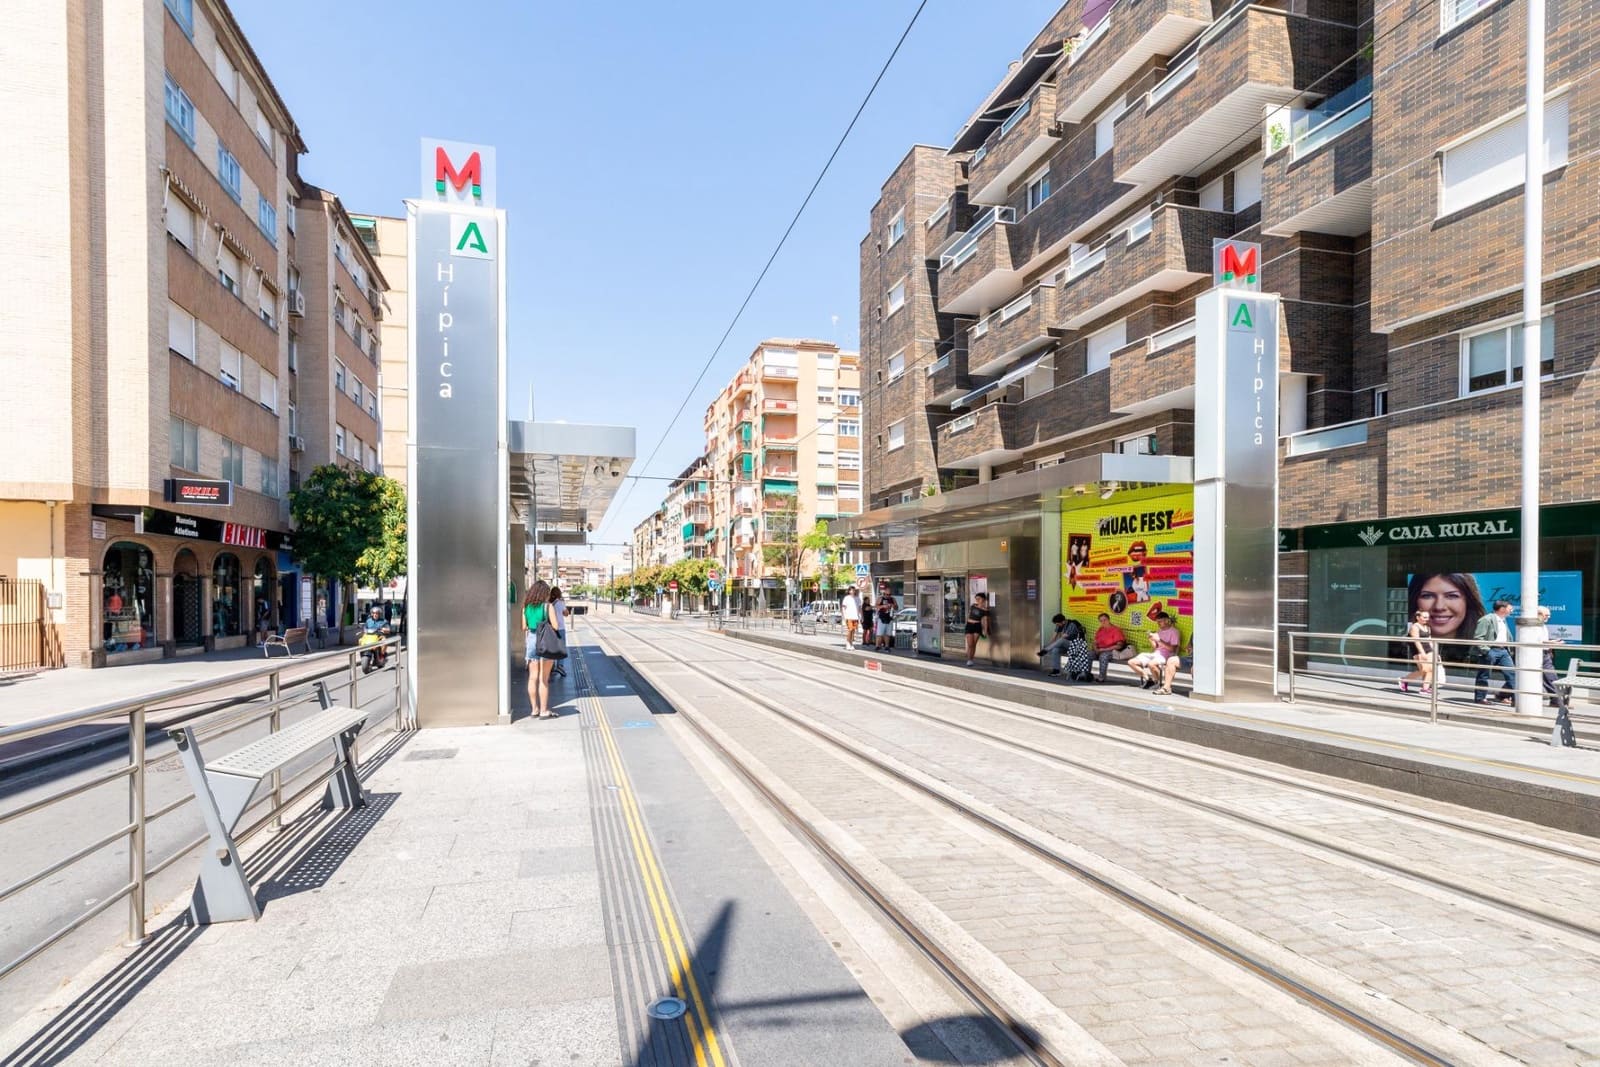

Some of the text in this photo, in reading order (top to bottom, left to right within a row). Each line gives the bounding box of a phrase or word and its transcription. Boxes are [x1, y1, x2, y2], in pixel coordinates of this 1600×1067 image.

[436, 146, 482, 197] M
[1221, 243, 1258, 284] M
[437, 262, 454, 399] Hípica
[1253, 339, 1264, 445] Hípica
[176, 515, 196, 527] Running
[223, 522, 267, 548] BIKILA
[1099, 514, 1137, 536] MUAC
[1141, 510, 1174, 532] FEST
[1389, 520, 1513, 540] CAJA RURAL
